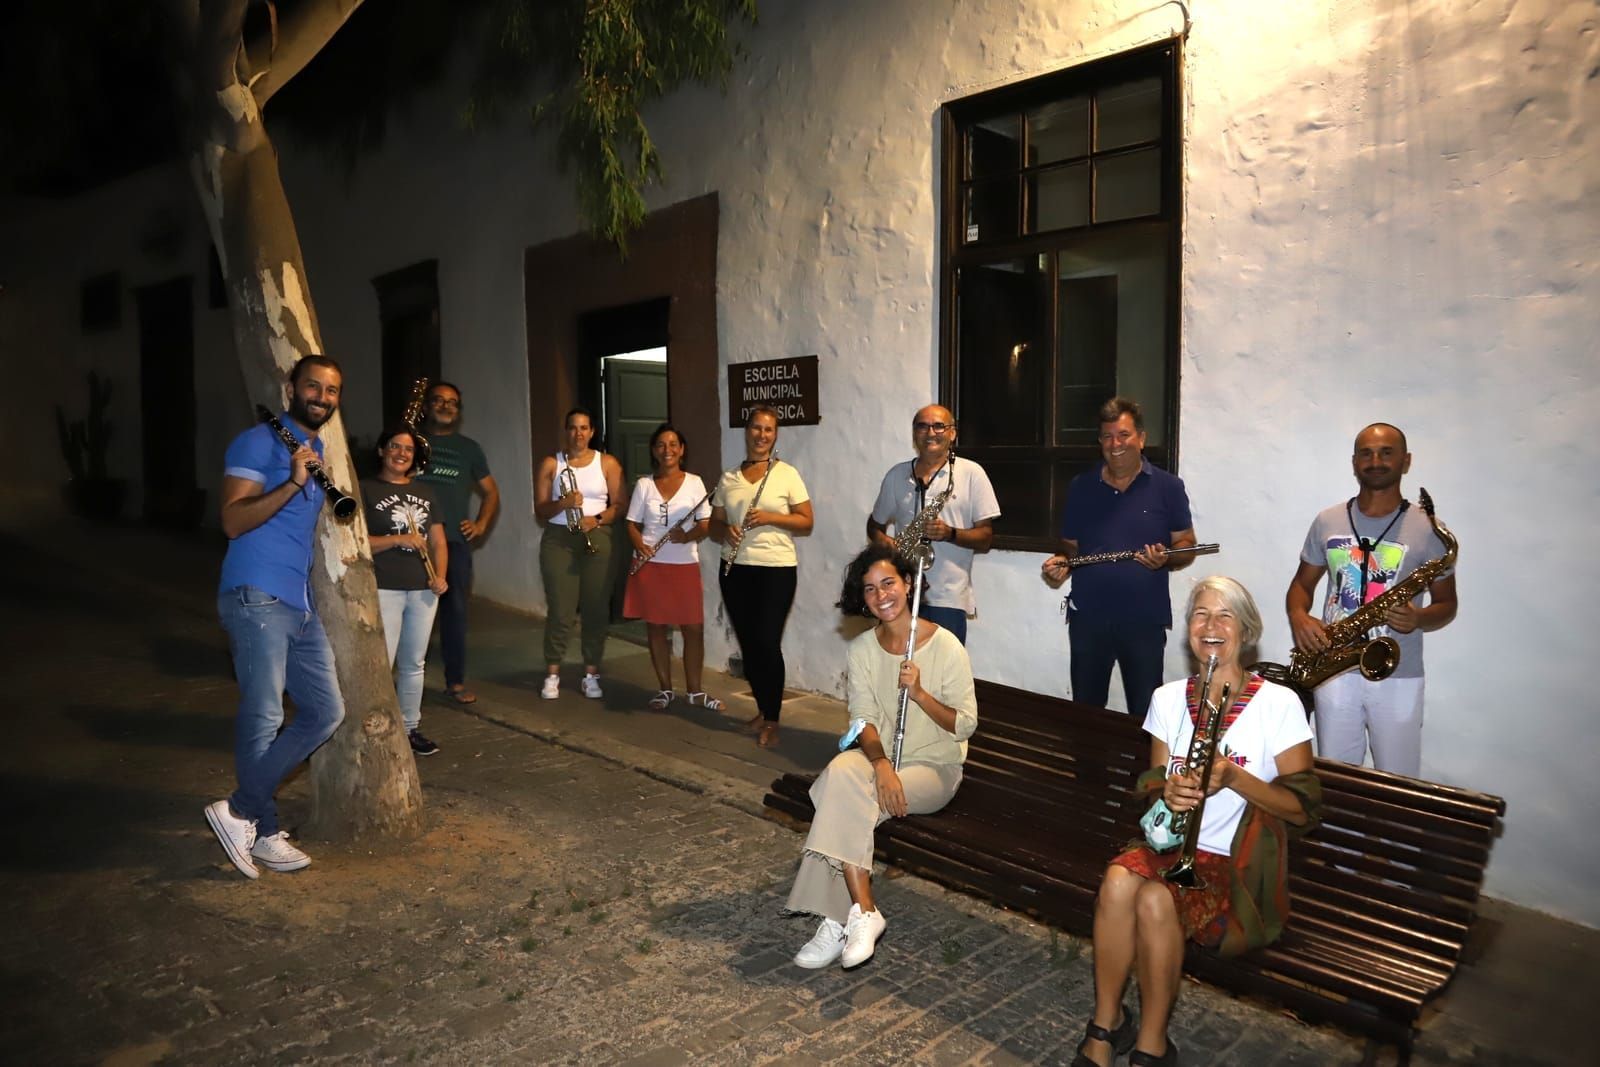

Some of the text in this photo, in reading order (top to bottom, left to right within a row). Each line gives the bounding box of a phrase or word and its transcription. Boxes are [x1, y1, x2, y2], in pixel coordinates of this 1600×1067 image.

[744, 364, 799, 382] ESCUELA
[743, 383, 802, 401] MUNICIPAL
[770, 402, 805, 420] SICA
[375, 494, 400, 511] PALM
